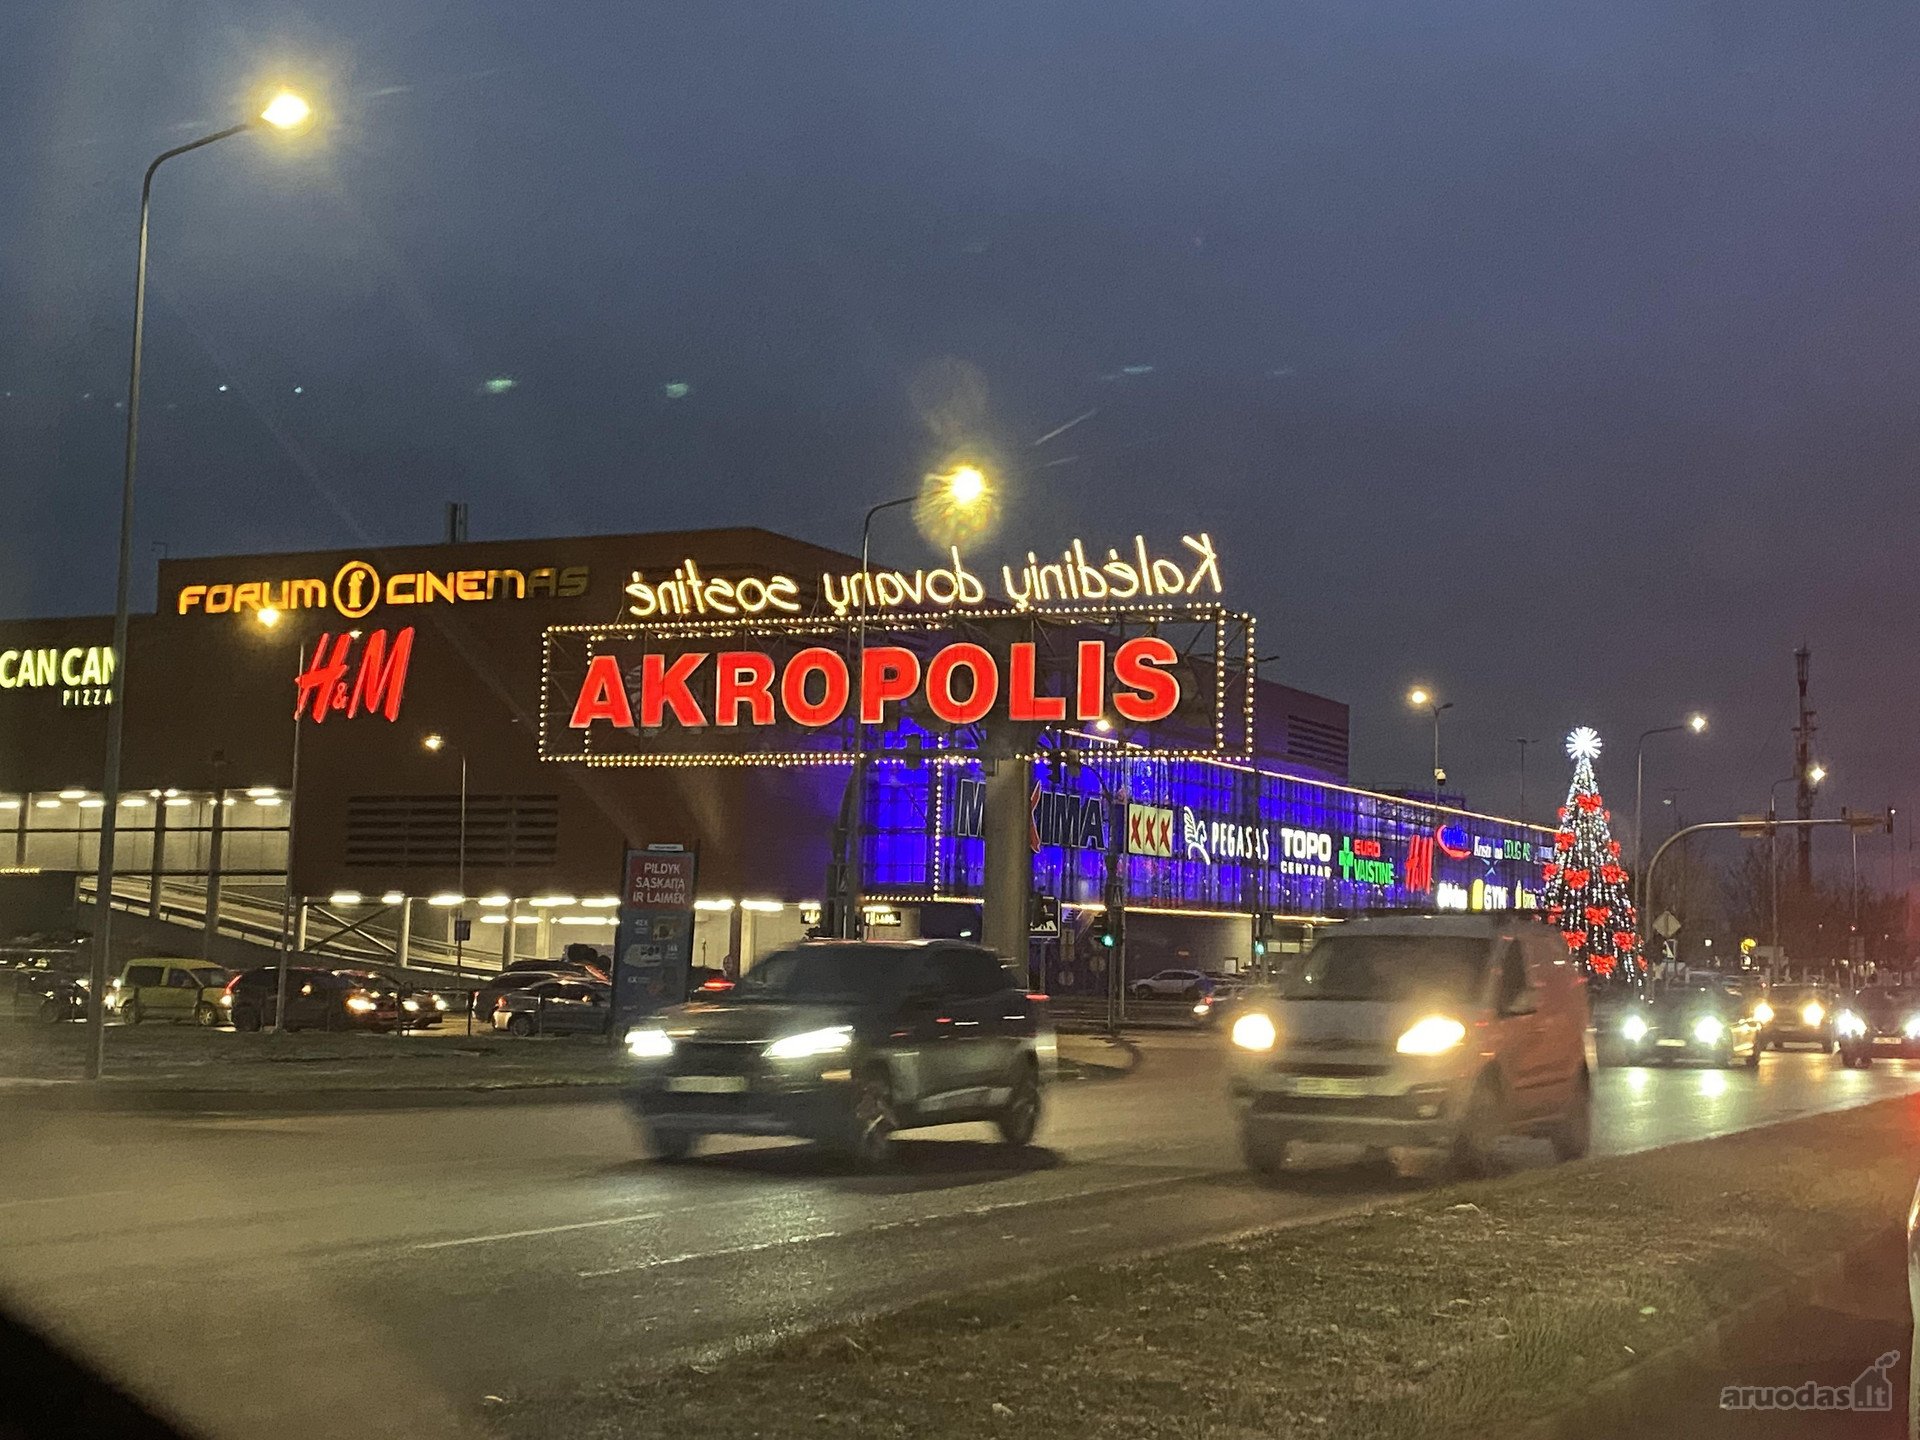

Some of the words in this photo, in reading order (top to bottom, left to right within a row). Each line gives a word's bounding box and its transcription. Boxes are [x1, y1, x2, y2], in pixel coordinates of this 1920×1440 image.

[178, 578, 327, 615] FORUM
[385, 566, 590, 605] CINEMAS
[0, 649, 58, 689] CAN
[294, 626, 415, 724] H&M
[568, 637, 1181, 729] AKROPOLIS
[62, 688, 113, 706] PIZZA
[957, 779, 1109, 853] MIMA
[1281, 827, 1332, 862] TOPO
[1354, 839, 1381, 858] EURO
[1503, 839, 1532, 862] DOUGAS
[644, 862, 681, 875] PILDYK
[632, 891, 645, 903] IR
